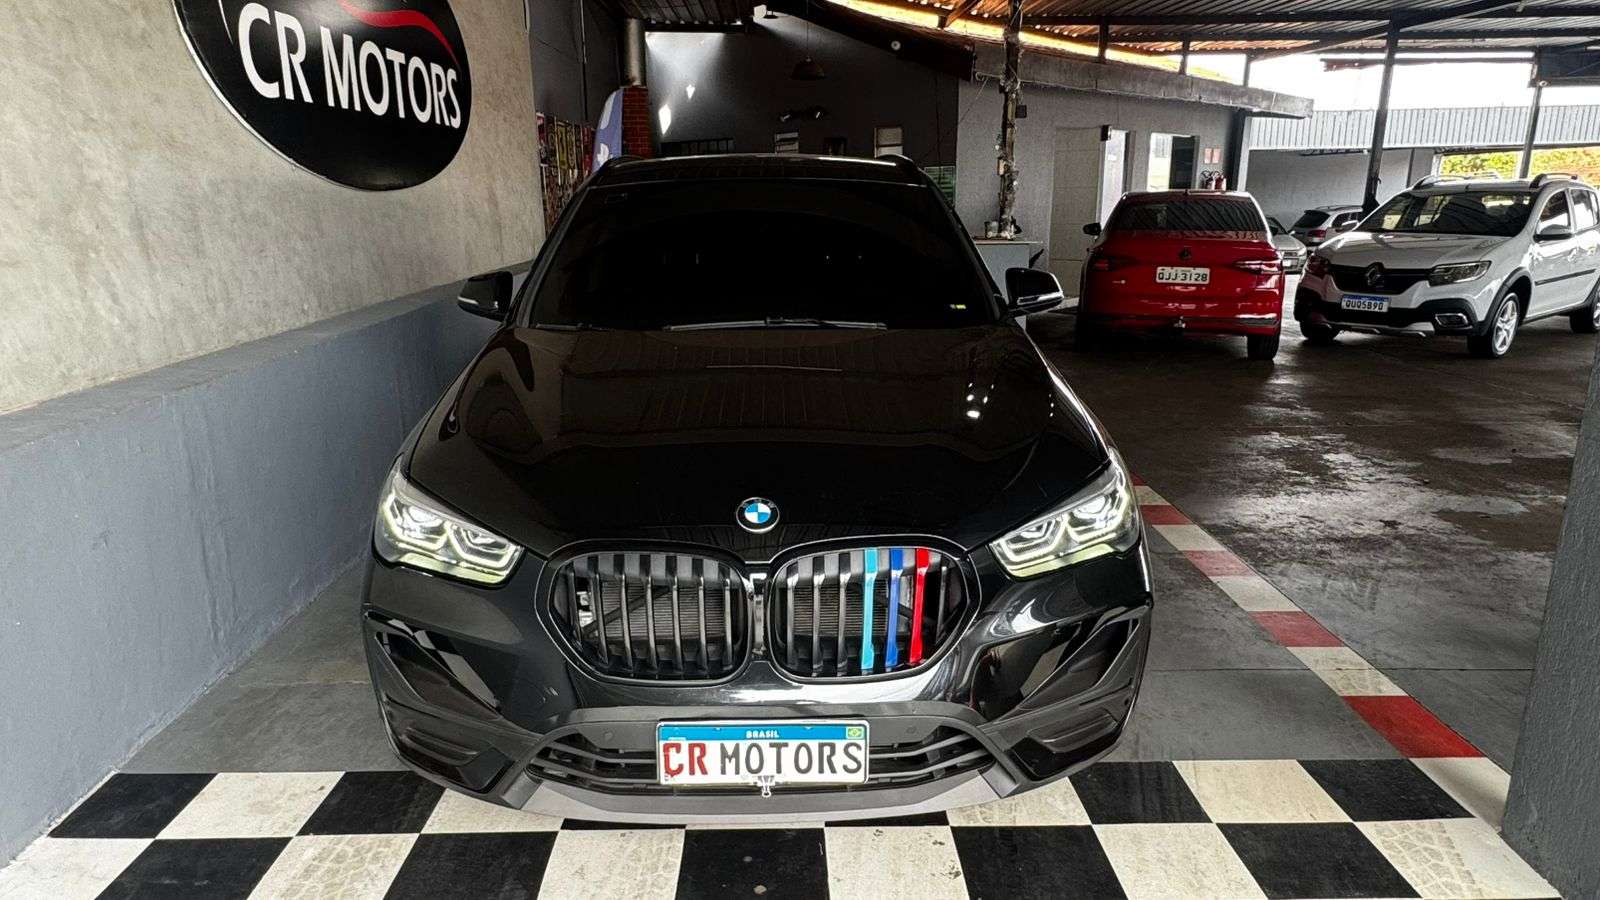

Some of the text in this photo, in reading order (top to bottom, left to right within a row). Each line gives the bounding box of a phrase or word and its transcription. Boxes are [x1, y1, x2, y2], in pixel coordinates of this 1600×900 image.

[238, 3, 461, 128] CR MOTORS
[745, 730, 780, 739] BRASIL
[663, 742, 863, 777] CR MOTORS
